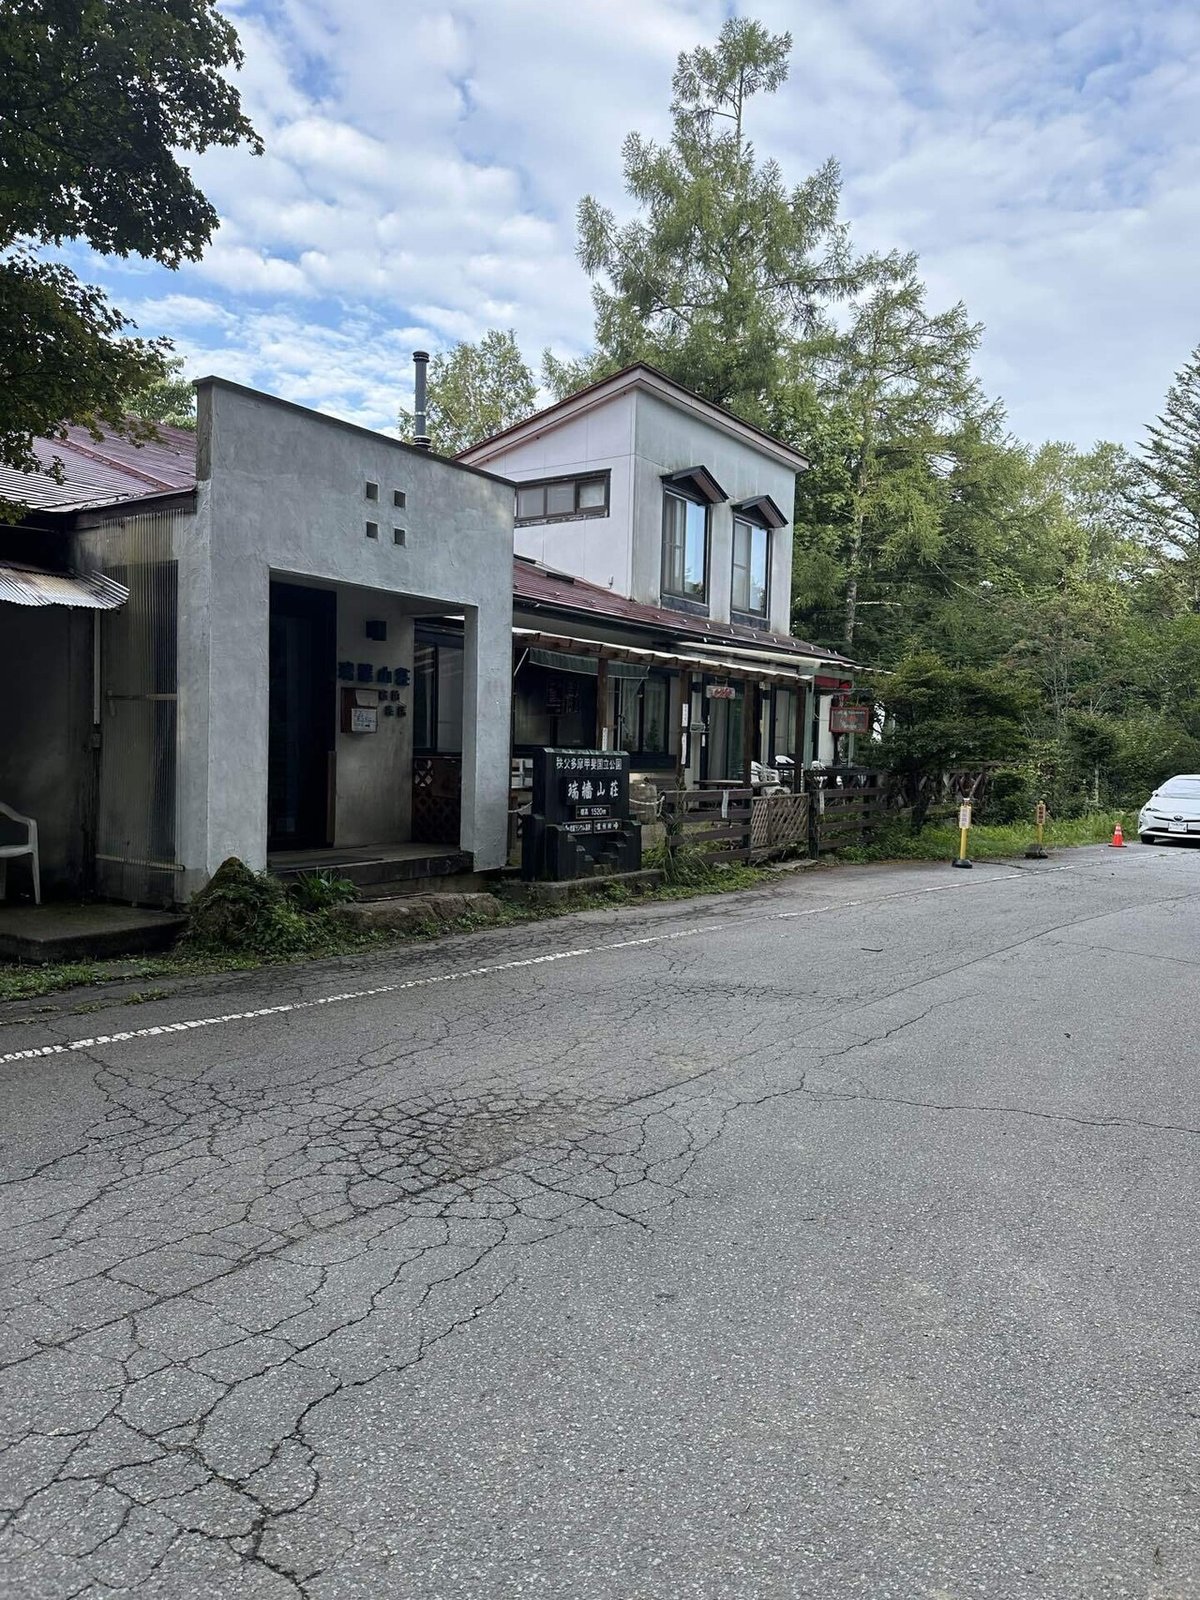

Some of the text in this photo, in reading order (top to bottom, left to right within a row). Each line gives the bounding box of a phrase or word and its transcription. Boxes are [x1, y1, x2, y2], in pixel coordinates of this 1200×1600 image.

[556, 757, 622, 770] 秩父多摩甲斐国立公園
[591, 807, 607, 816] 1520m
